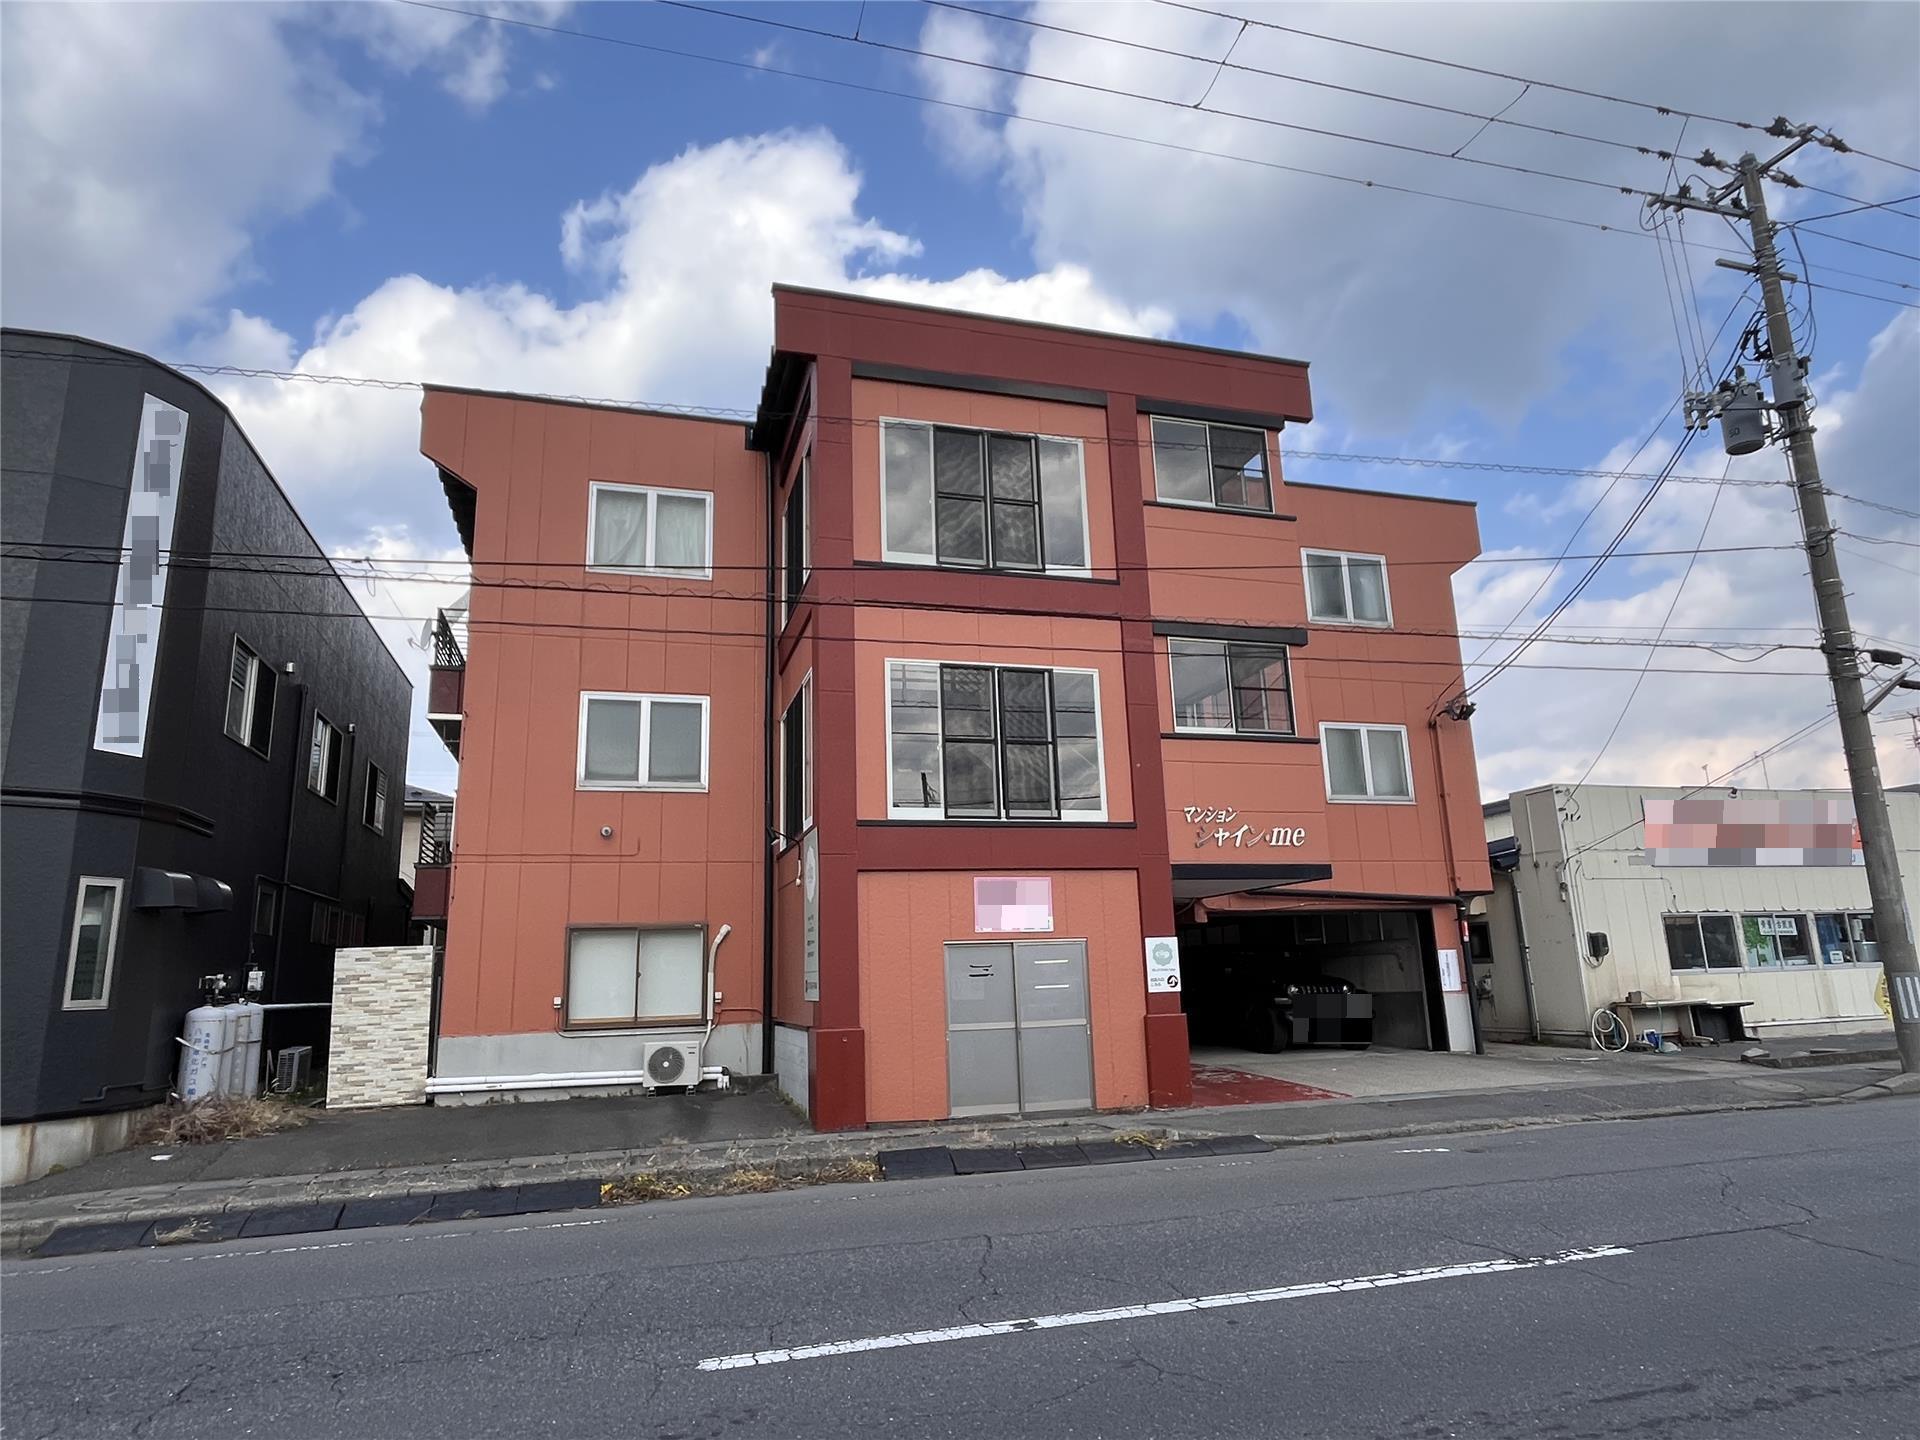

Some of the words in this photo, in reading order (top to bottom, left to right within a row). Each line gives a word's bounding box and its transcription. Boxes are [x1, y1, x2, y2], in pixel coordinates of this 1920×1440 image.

[1183, 805, 1238, 823] マンション
